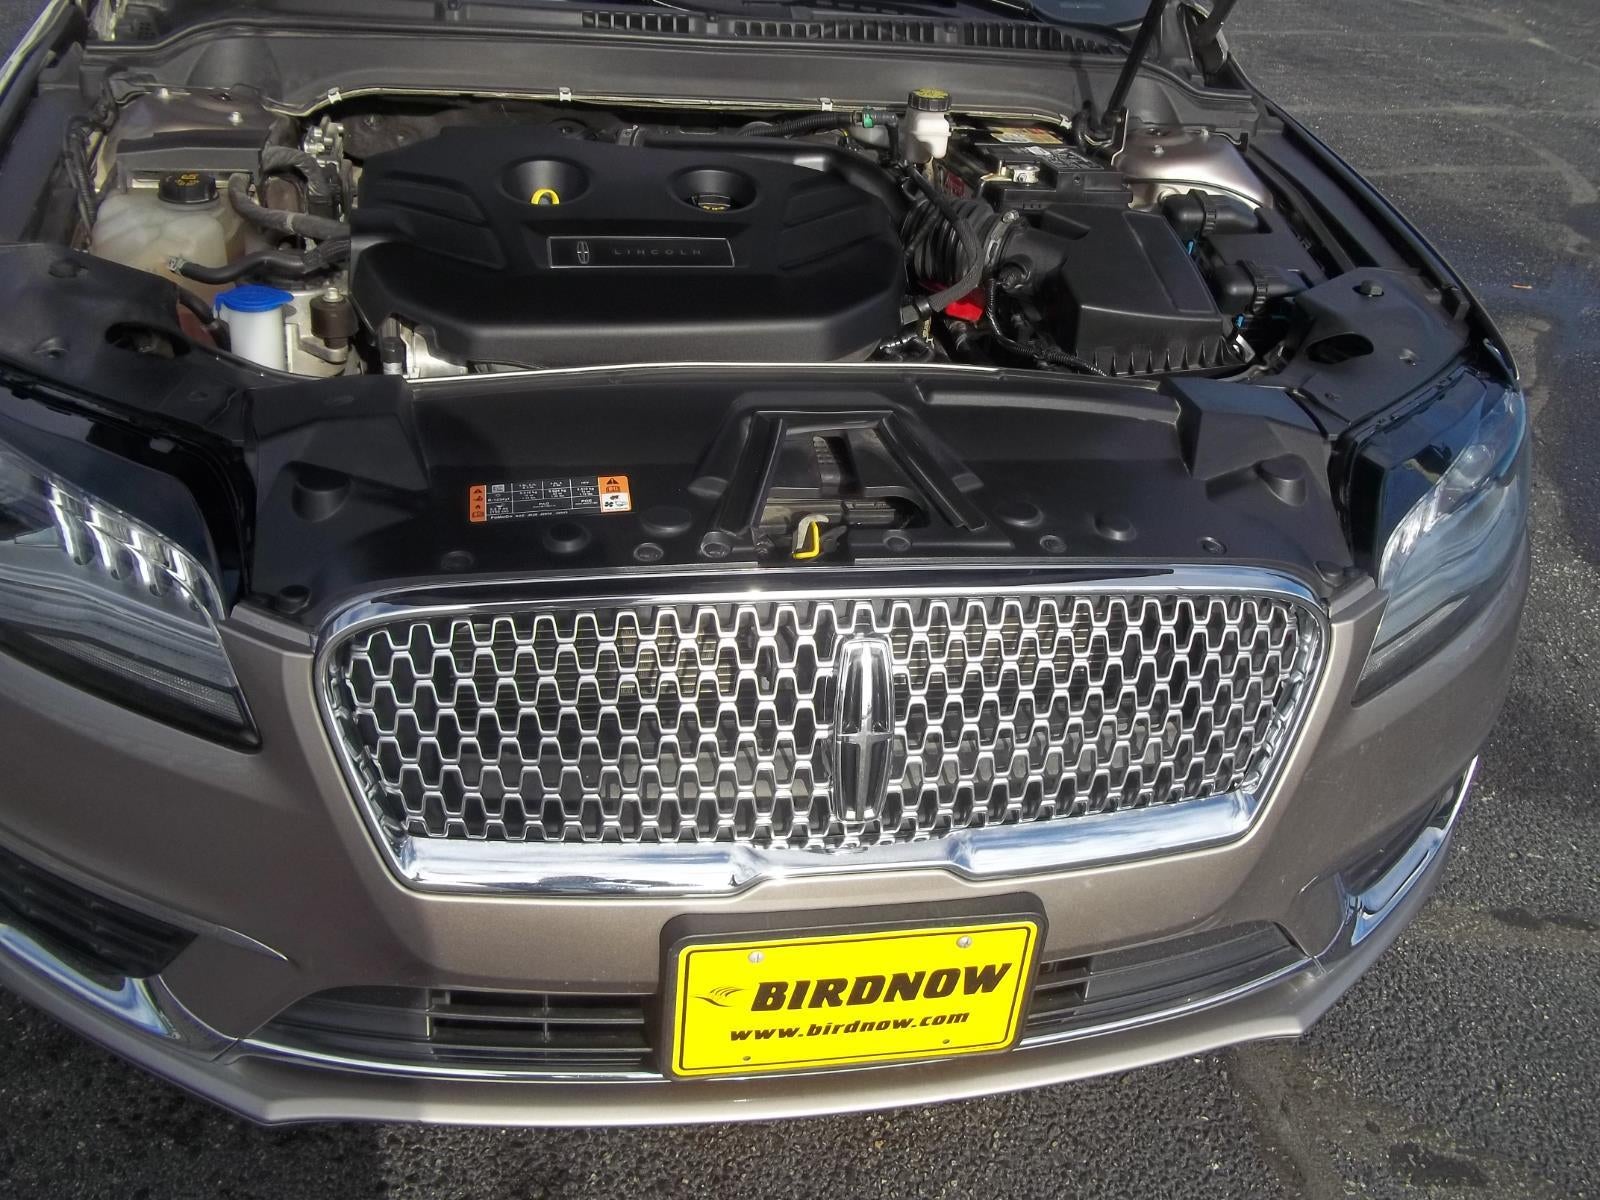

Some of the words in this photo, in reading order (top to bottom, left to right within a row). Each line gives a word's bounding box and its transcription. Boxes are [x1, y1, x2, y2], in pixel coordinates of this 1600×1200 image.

[613, 248, 702, 256] LINCOLN
[750, 962, 1013, 1012] BIRDNOW
[730, 1011, 970, 1042] www.birdnow.com
